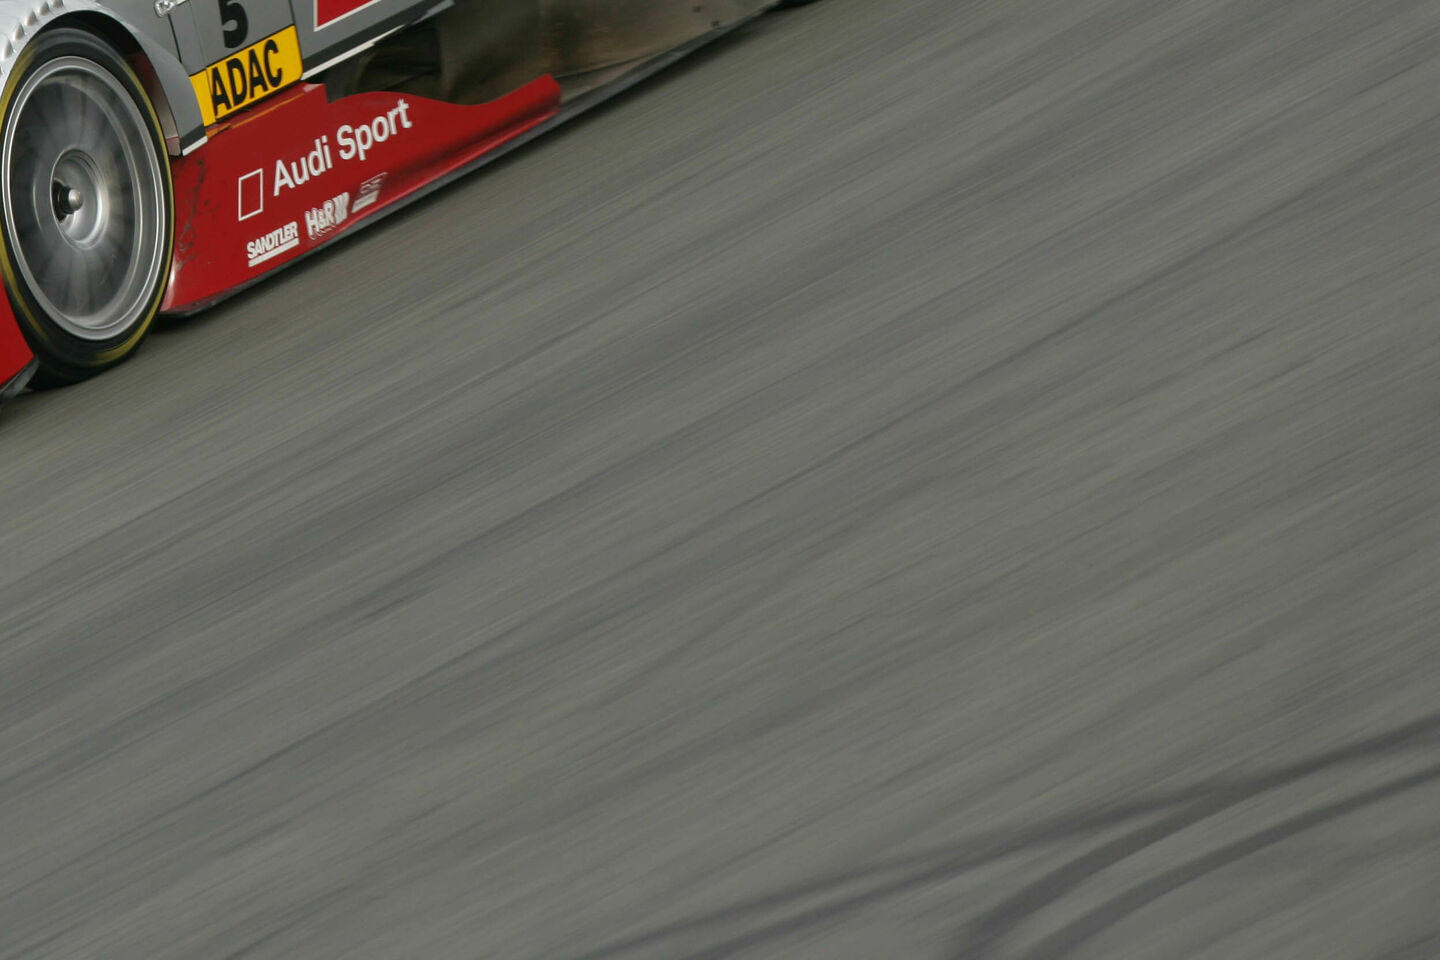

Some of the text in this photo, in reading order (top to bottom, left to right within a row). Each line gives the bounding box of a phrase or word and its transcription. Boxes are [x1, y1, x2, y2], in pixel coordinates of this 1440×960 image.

[211, 39, 283, 117] ADAC
[273, 98, 413, 197] Audi Sport
